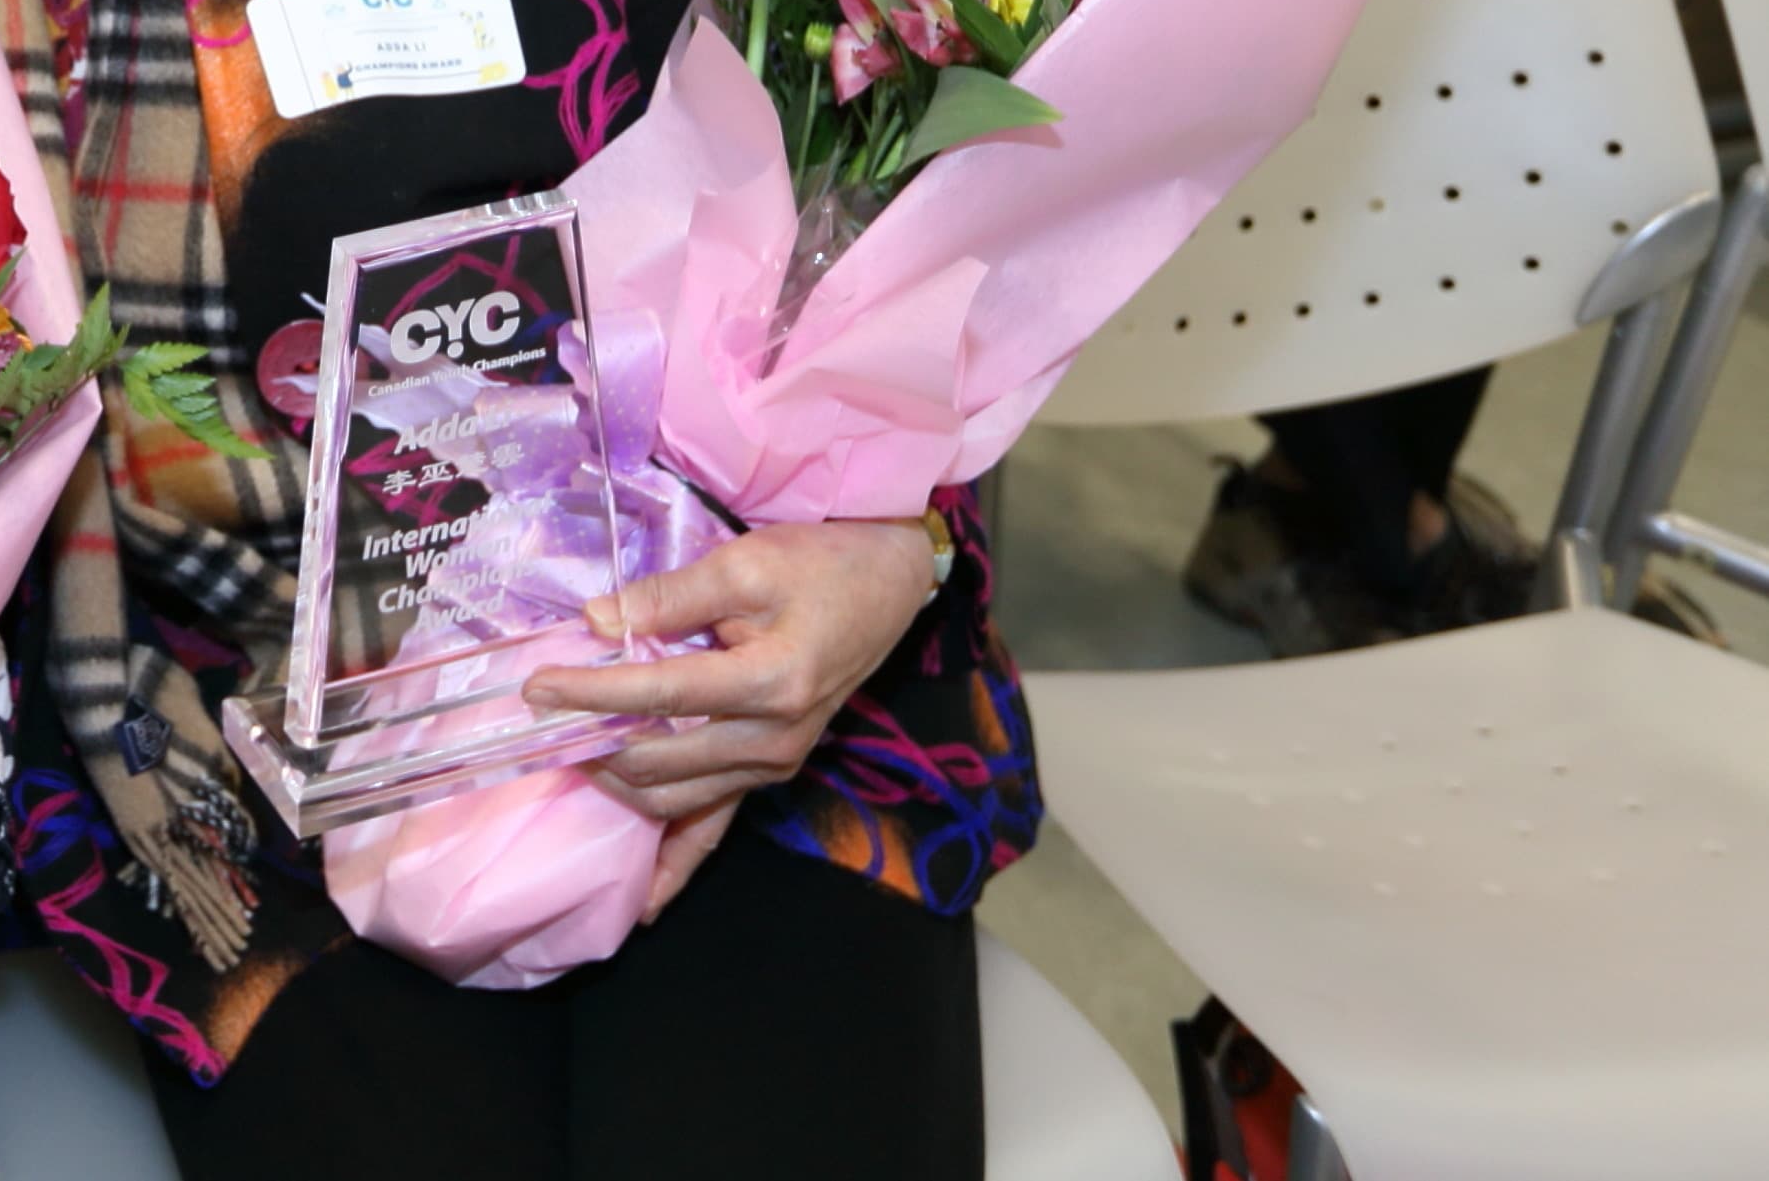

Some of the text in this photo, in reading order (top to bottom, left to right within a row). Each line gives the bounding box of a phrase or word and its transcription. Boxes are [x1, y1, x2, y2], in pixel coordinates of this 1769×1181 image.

[390, 290, 521, 365] CYC
[368, 374, 430, 398] Canadian
[473, 347, 547, 374] Champions
[393, 411, 478, 456] Adda
[361, 489, 556, 561] Internatil
[377, 559, 532, 614] Chapio
